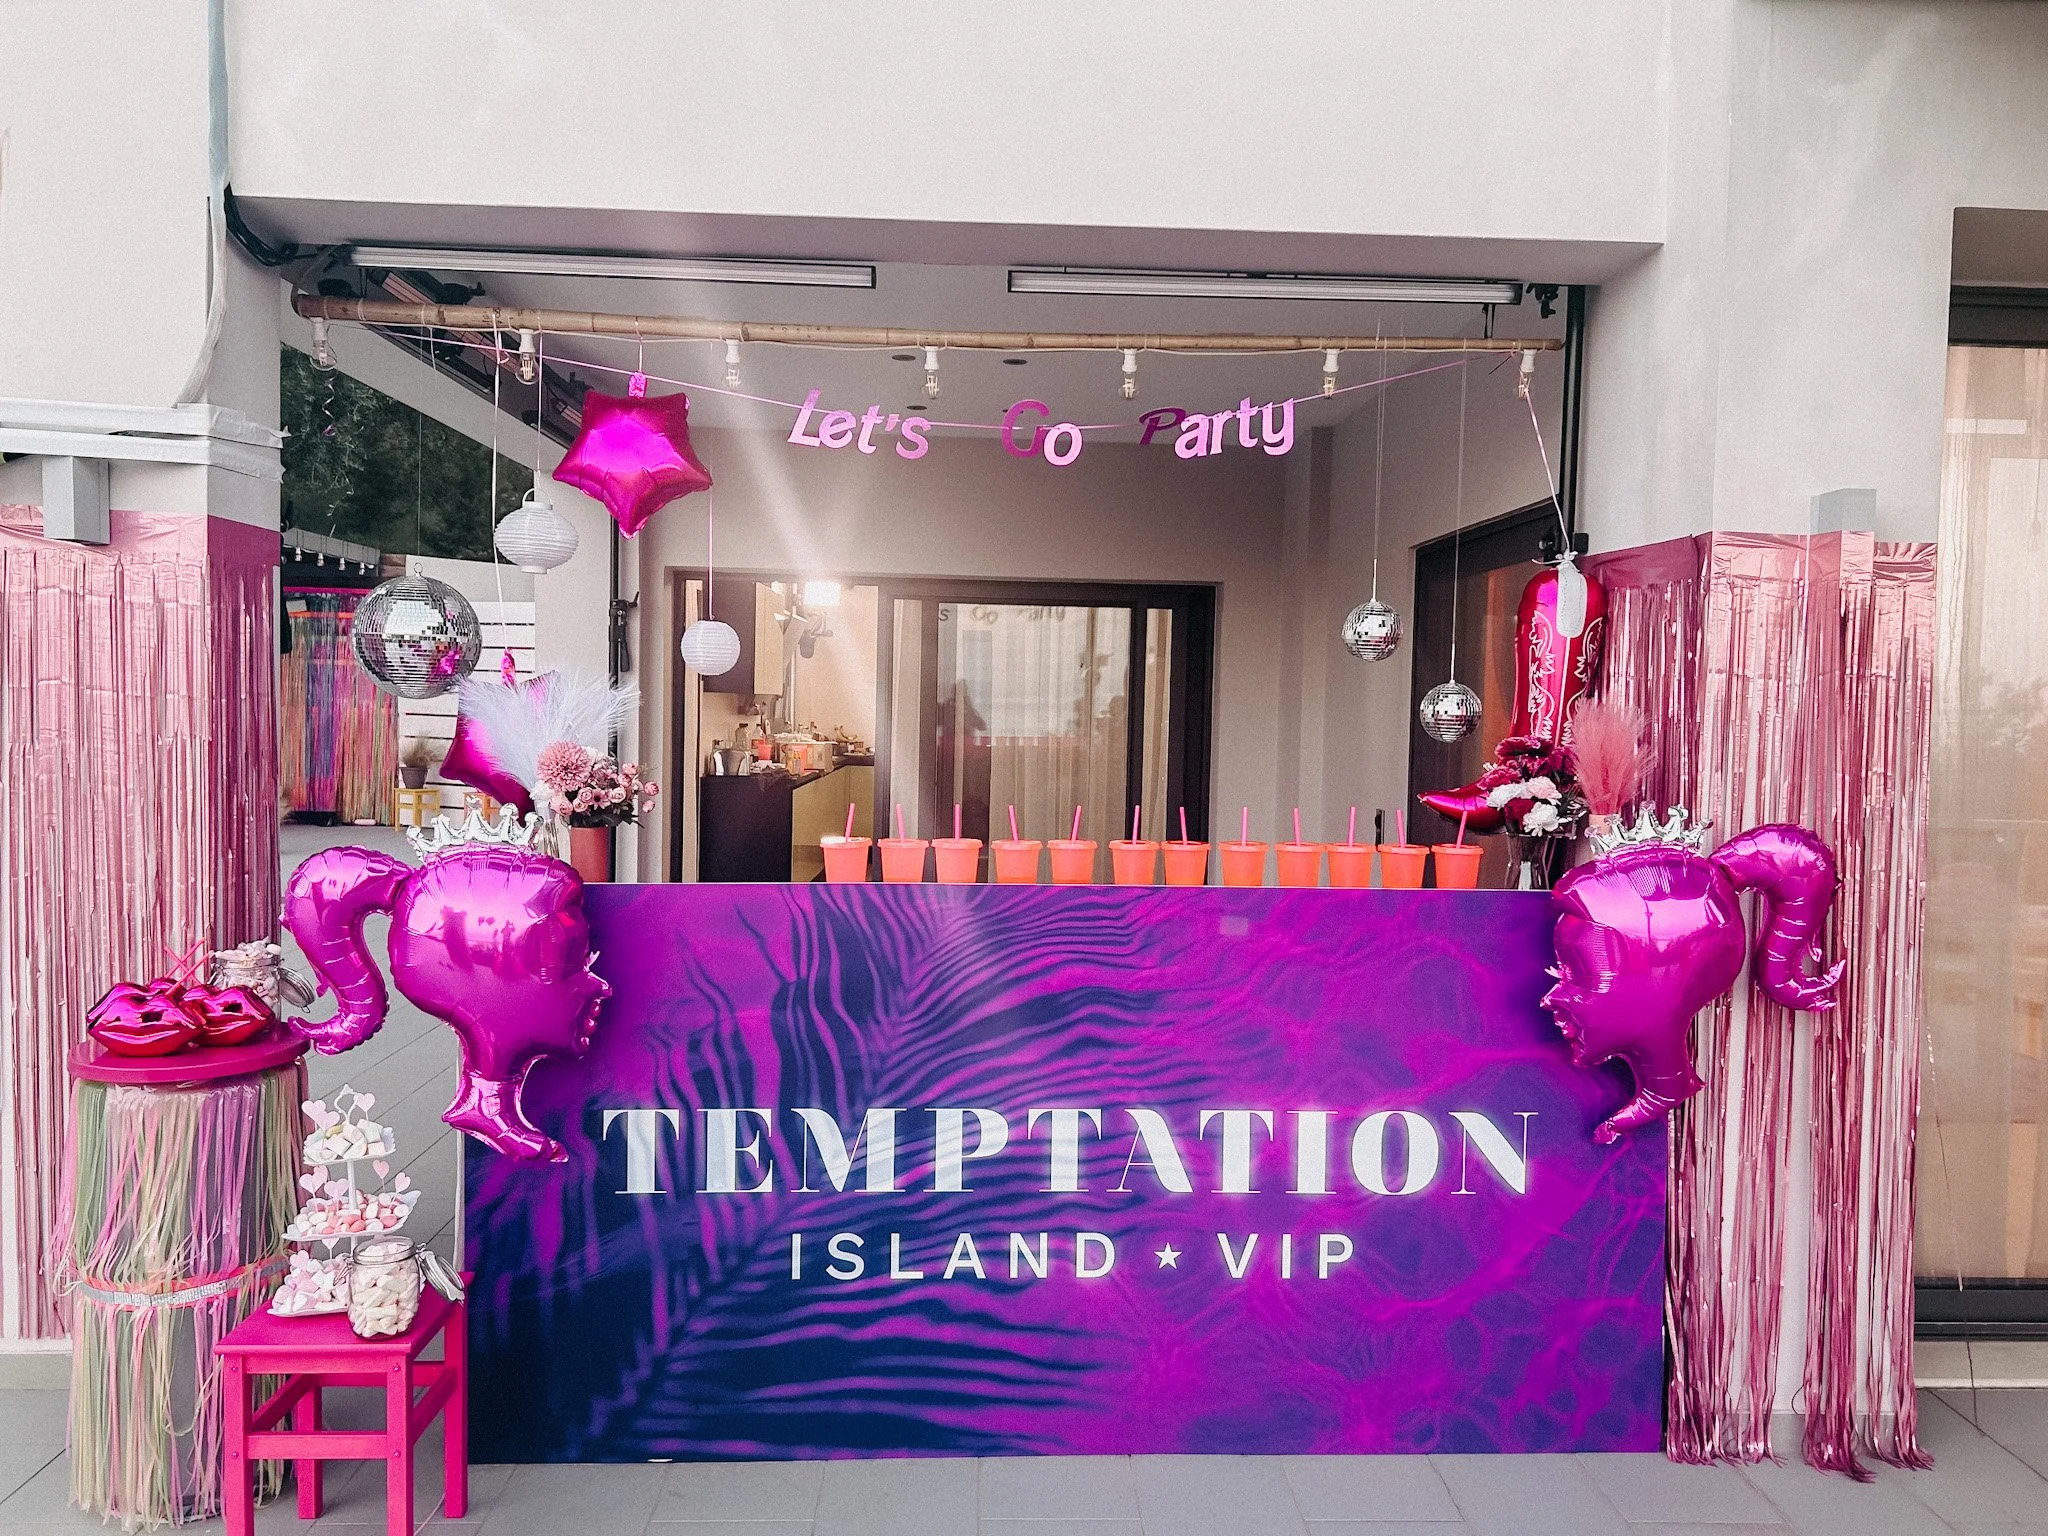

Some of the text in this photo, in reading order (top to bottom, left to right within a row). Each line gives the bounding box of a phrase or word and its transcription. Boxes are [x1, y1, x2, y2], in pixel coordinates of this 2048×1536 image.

[787, 387, 1296, 466] Let's Go Party
[602, 1107, 1539, 1196] TEMPTATION
[791, 1232, 1355, 1281] ISLAND VIP
